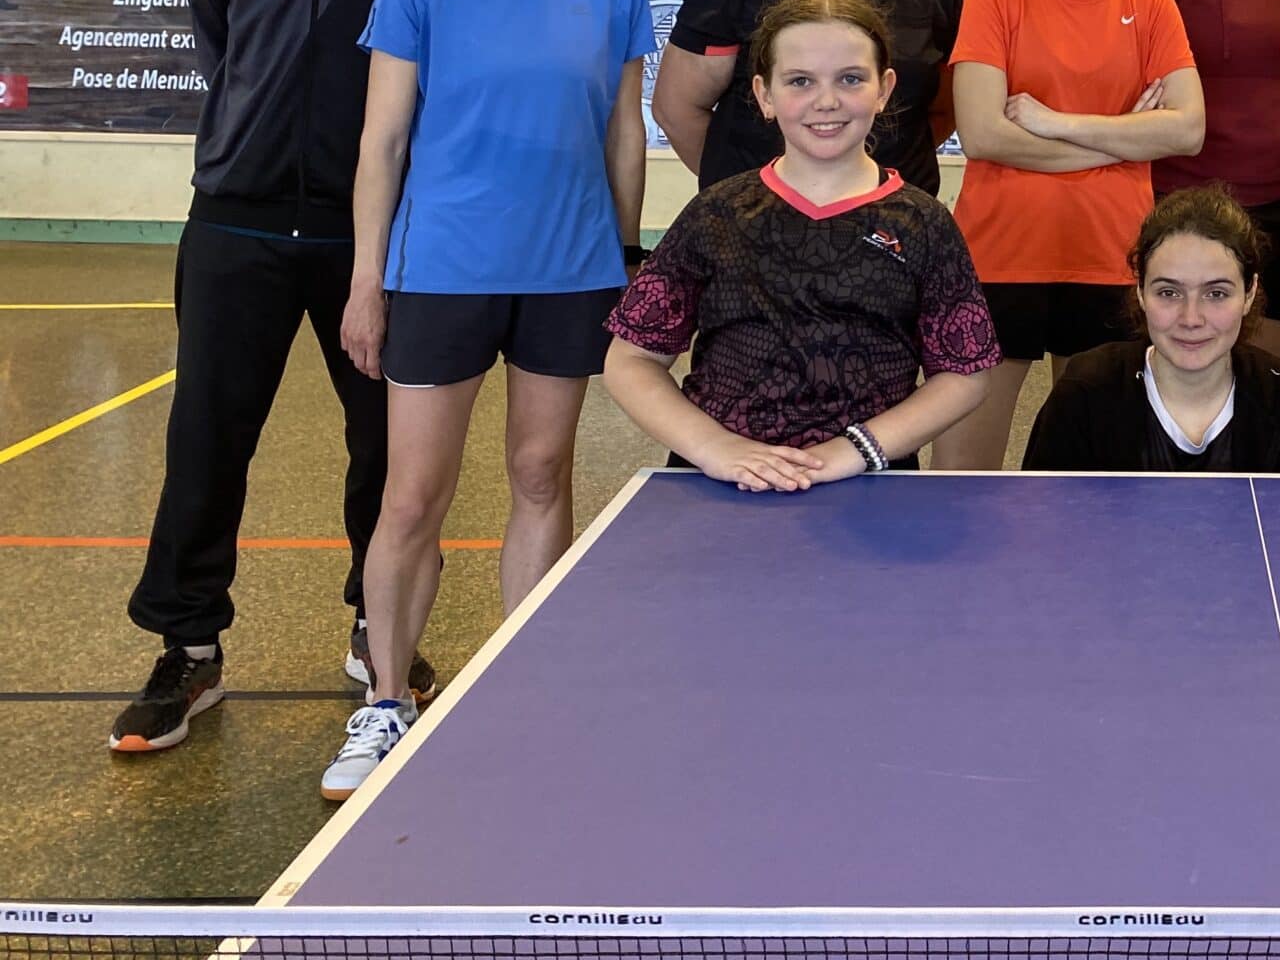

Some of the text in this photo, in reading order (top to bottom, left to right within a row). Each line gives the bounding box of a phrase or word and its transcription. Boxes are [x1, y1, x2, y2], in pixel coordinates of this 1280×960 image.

[59, 26, 167, 51] Agencement
[72, 67, 113, 89] Pose
[117, 68, 138, 89] de
